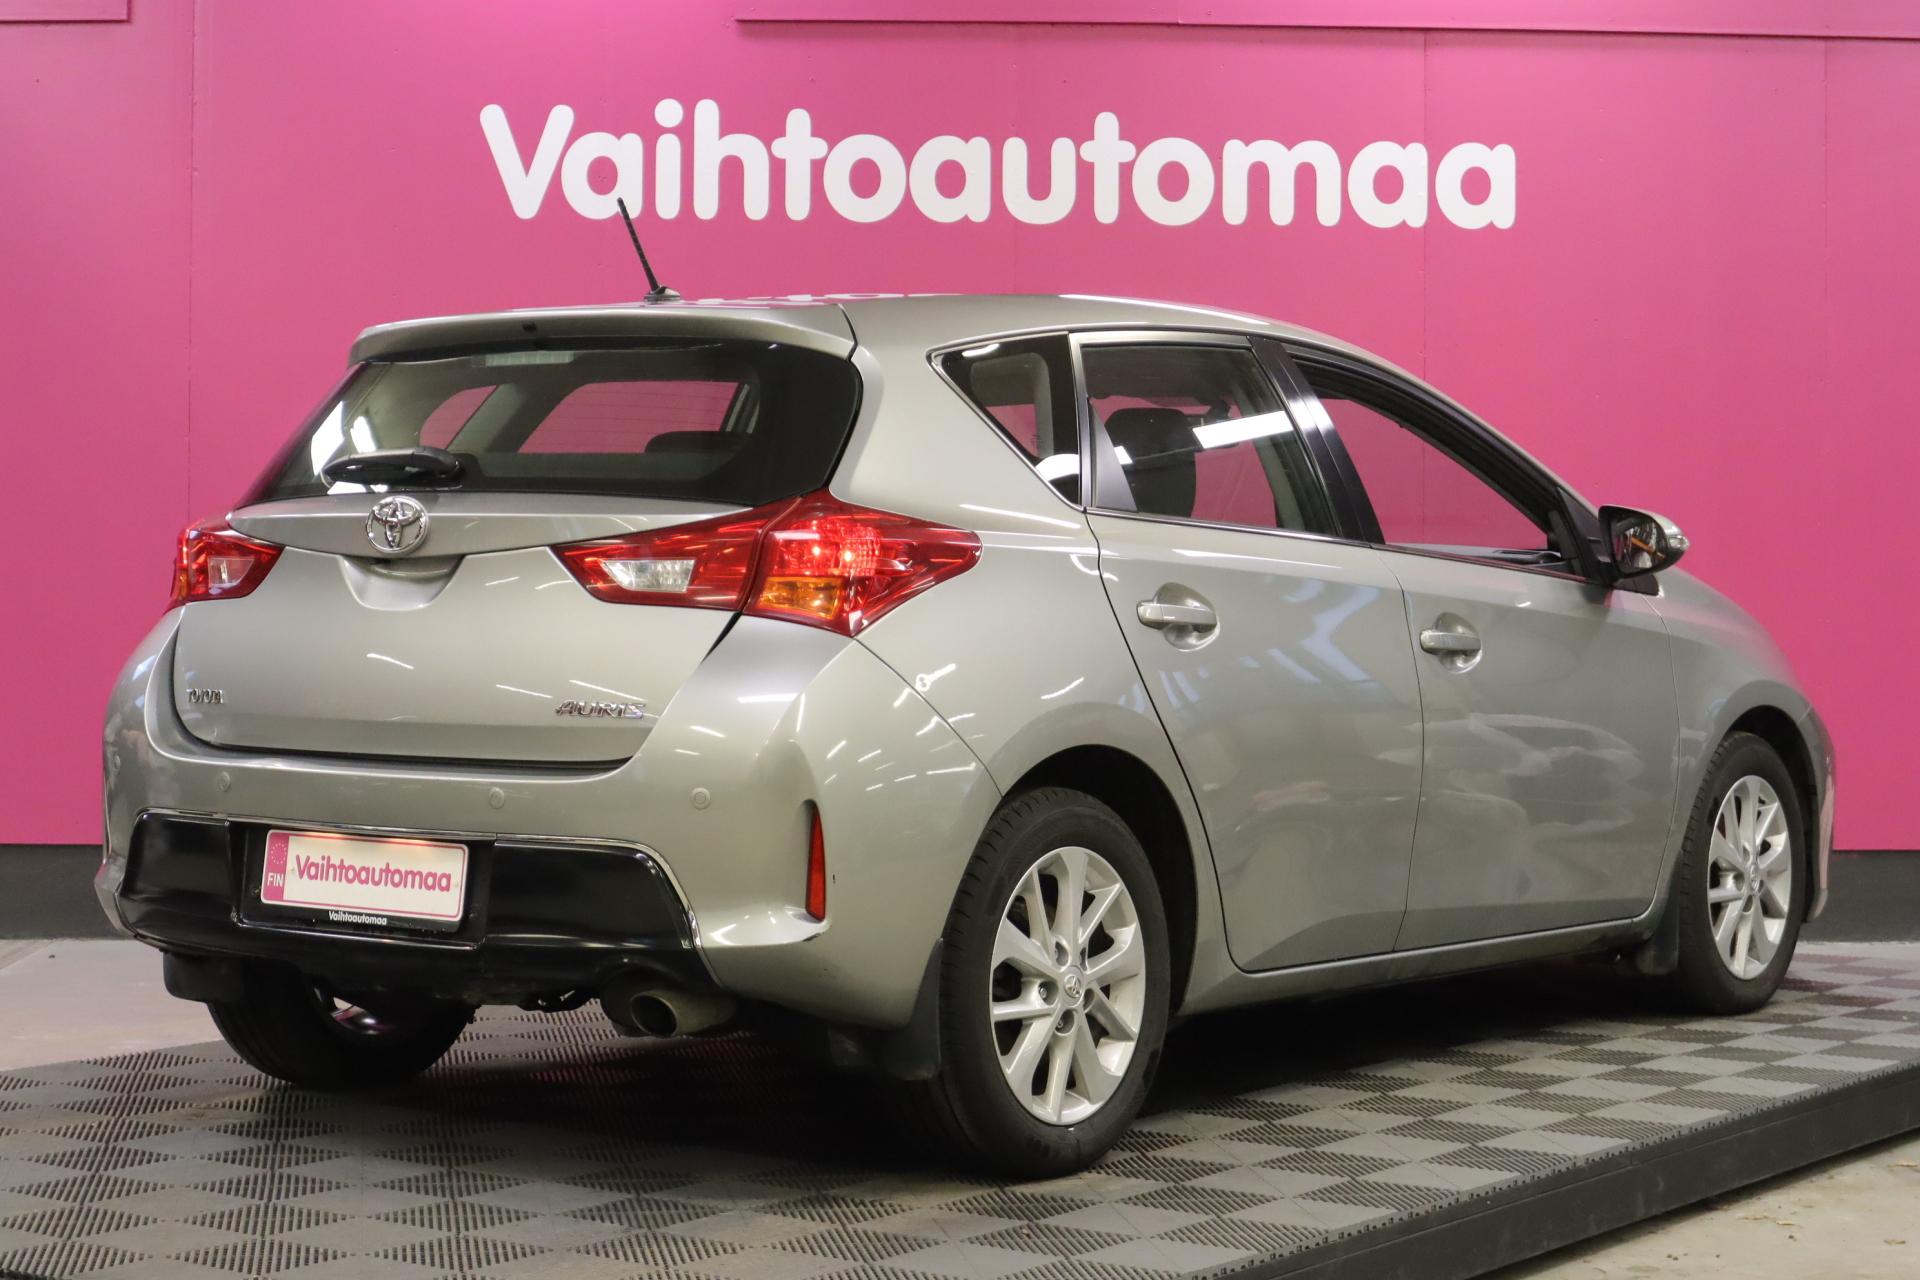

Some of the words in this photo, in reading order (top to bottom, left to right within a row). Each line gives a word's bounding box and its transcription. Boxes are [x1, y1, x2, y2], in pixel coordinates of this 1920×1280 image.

[480, 98, 1516, 230] Vaihtoautomaa
[555, 699, 646, 719] AURIS
[267, 872, 284, 888] FIN
[296, 854, 451, 892] Vaihtoautomaa
[328, 910, 388, 926] Vaihtoautomaa
